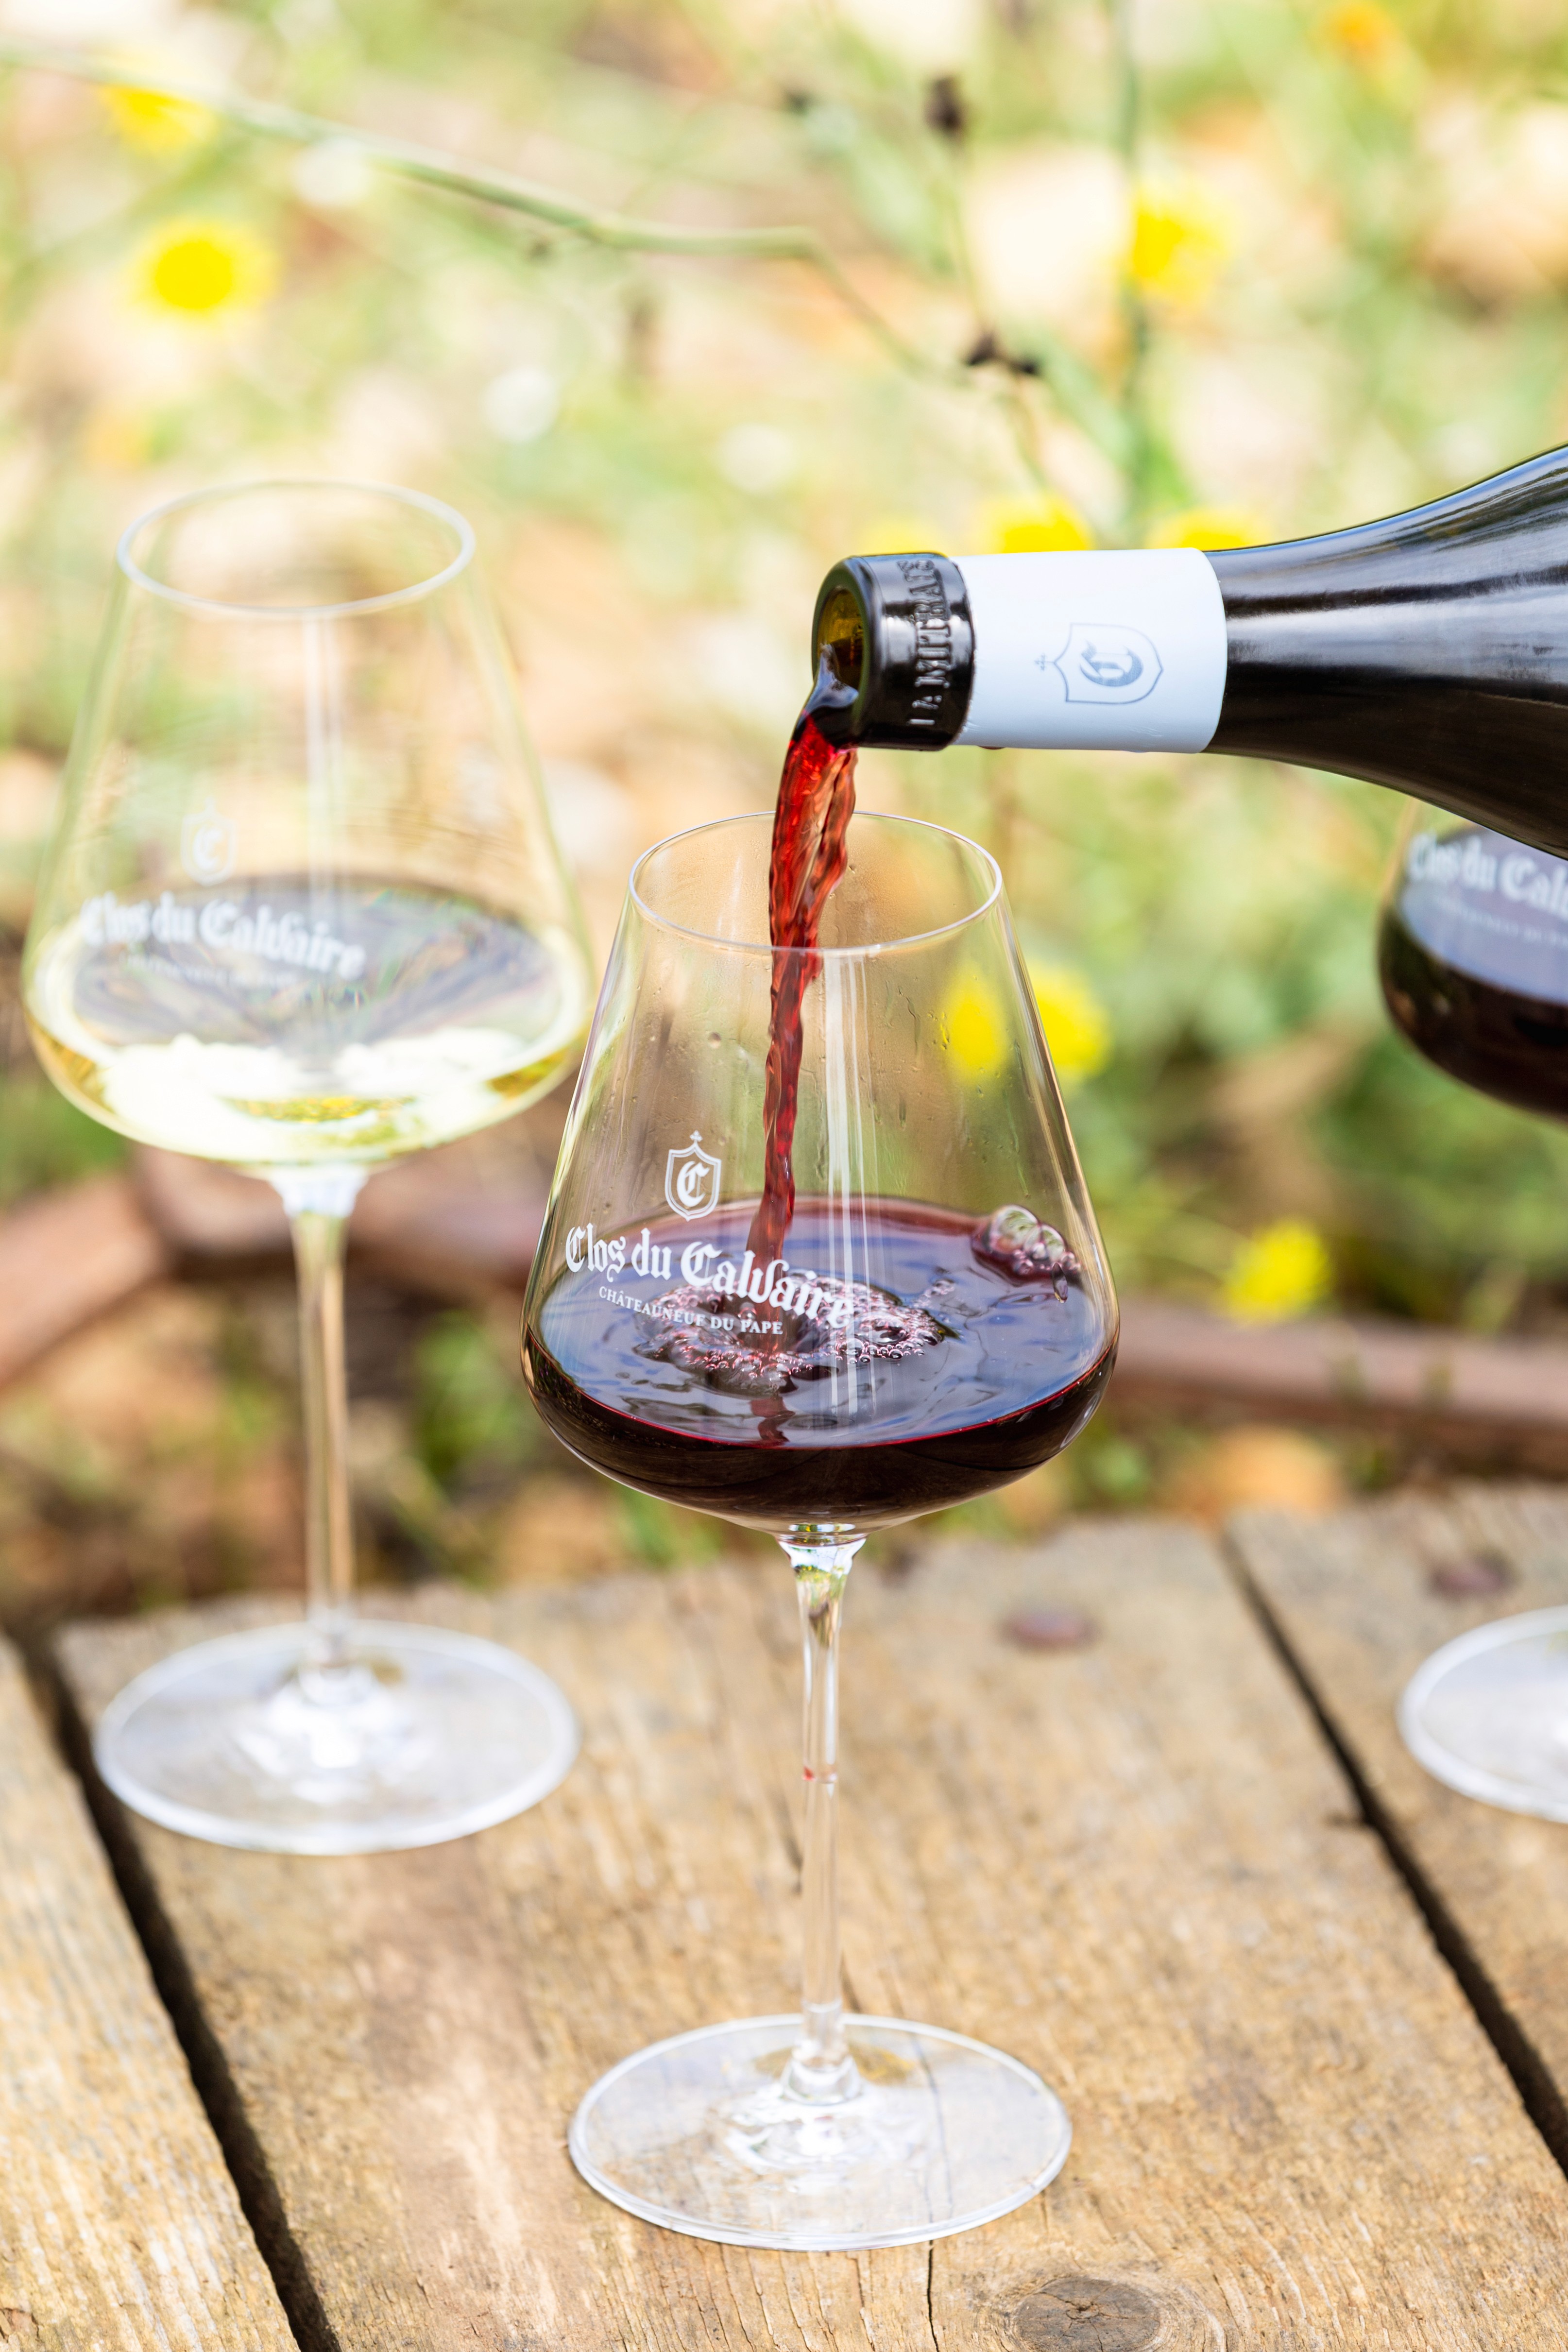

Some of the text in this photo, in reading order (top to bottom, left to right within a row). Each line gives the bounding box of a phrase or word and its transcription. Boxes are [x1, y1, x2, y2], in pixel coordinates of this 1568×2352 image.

[152, 891, 197, 945] du
[564, 1222, 855, 1329] Clos du Calvaire
[599, 1285, 784, 1335] CHÂTEAUNEUF DU PAPE
